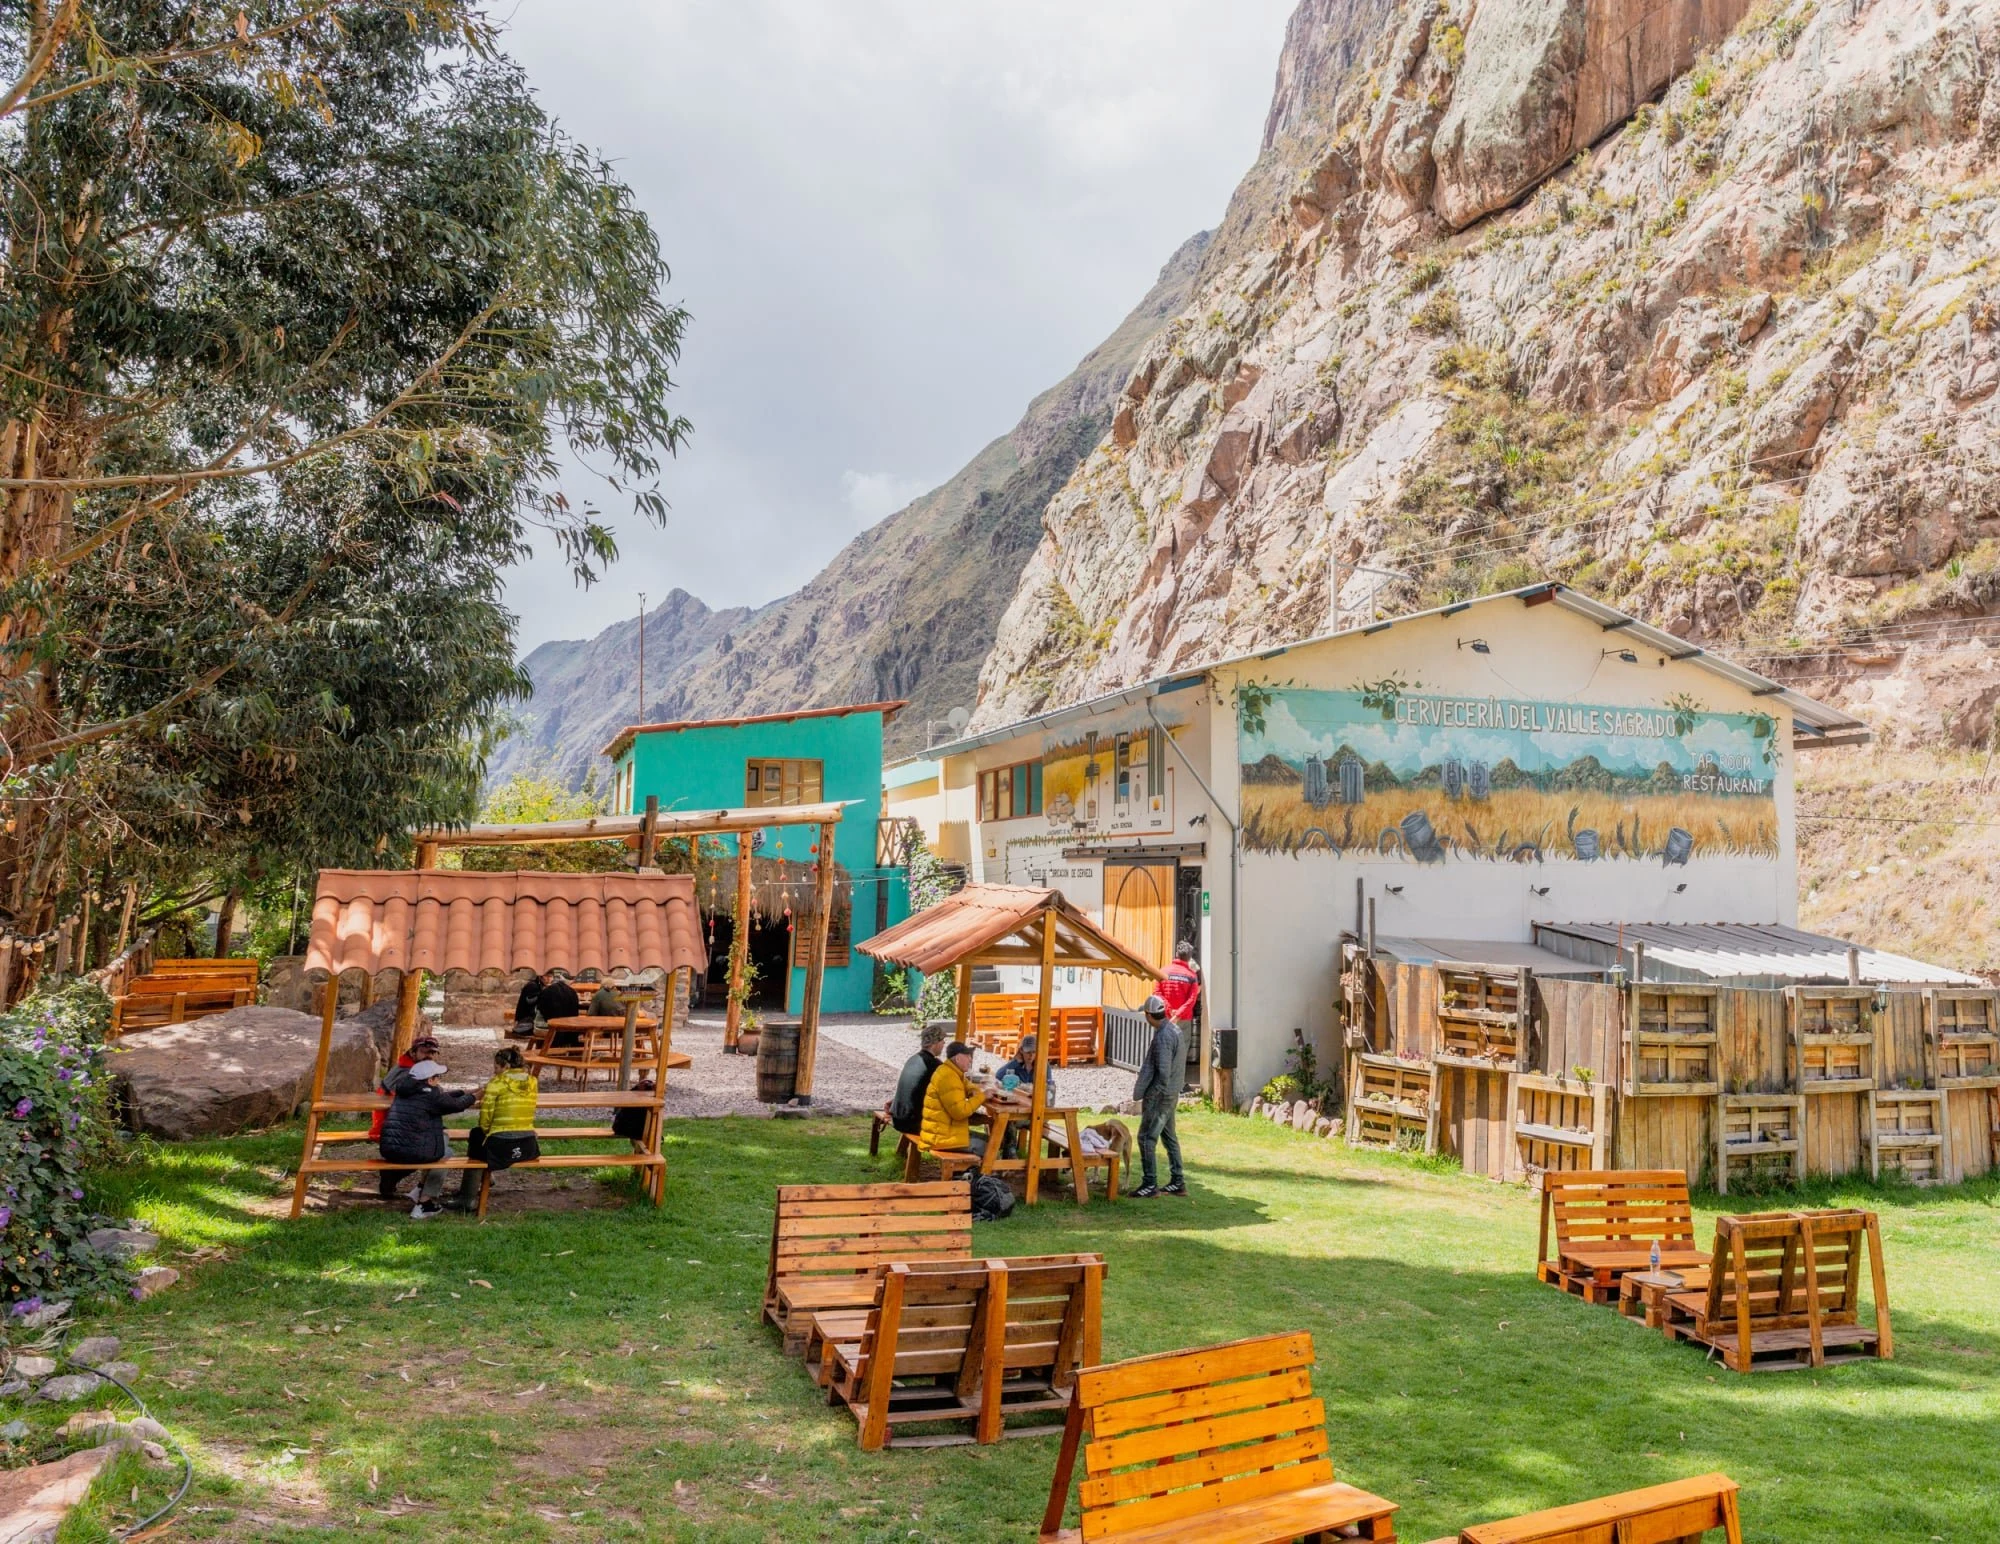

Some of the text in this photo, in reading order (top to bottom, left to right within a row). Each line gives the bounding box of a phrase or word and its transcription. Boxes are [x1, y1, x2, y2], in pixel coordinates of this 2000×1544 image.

[1394, 694, 1676, 738] CERVECERÍA DEL VALLE SAGRADO
[1690, 752, 1753, 771] TAP ROOM
[1682, 774, 1765, 794] RESTAURANT
